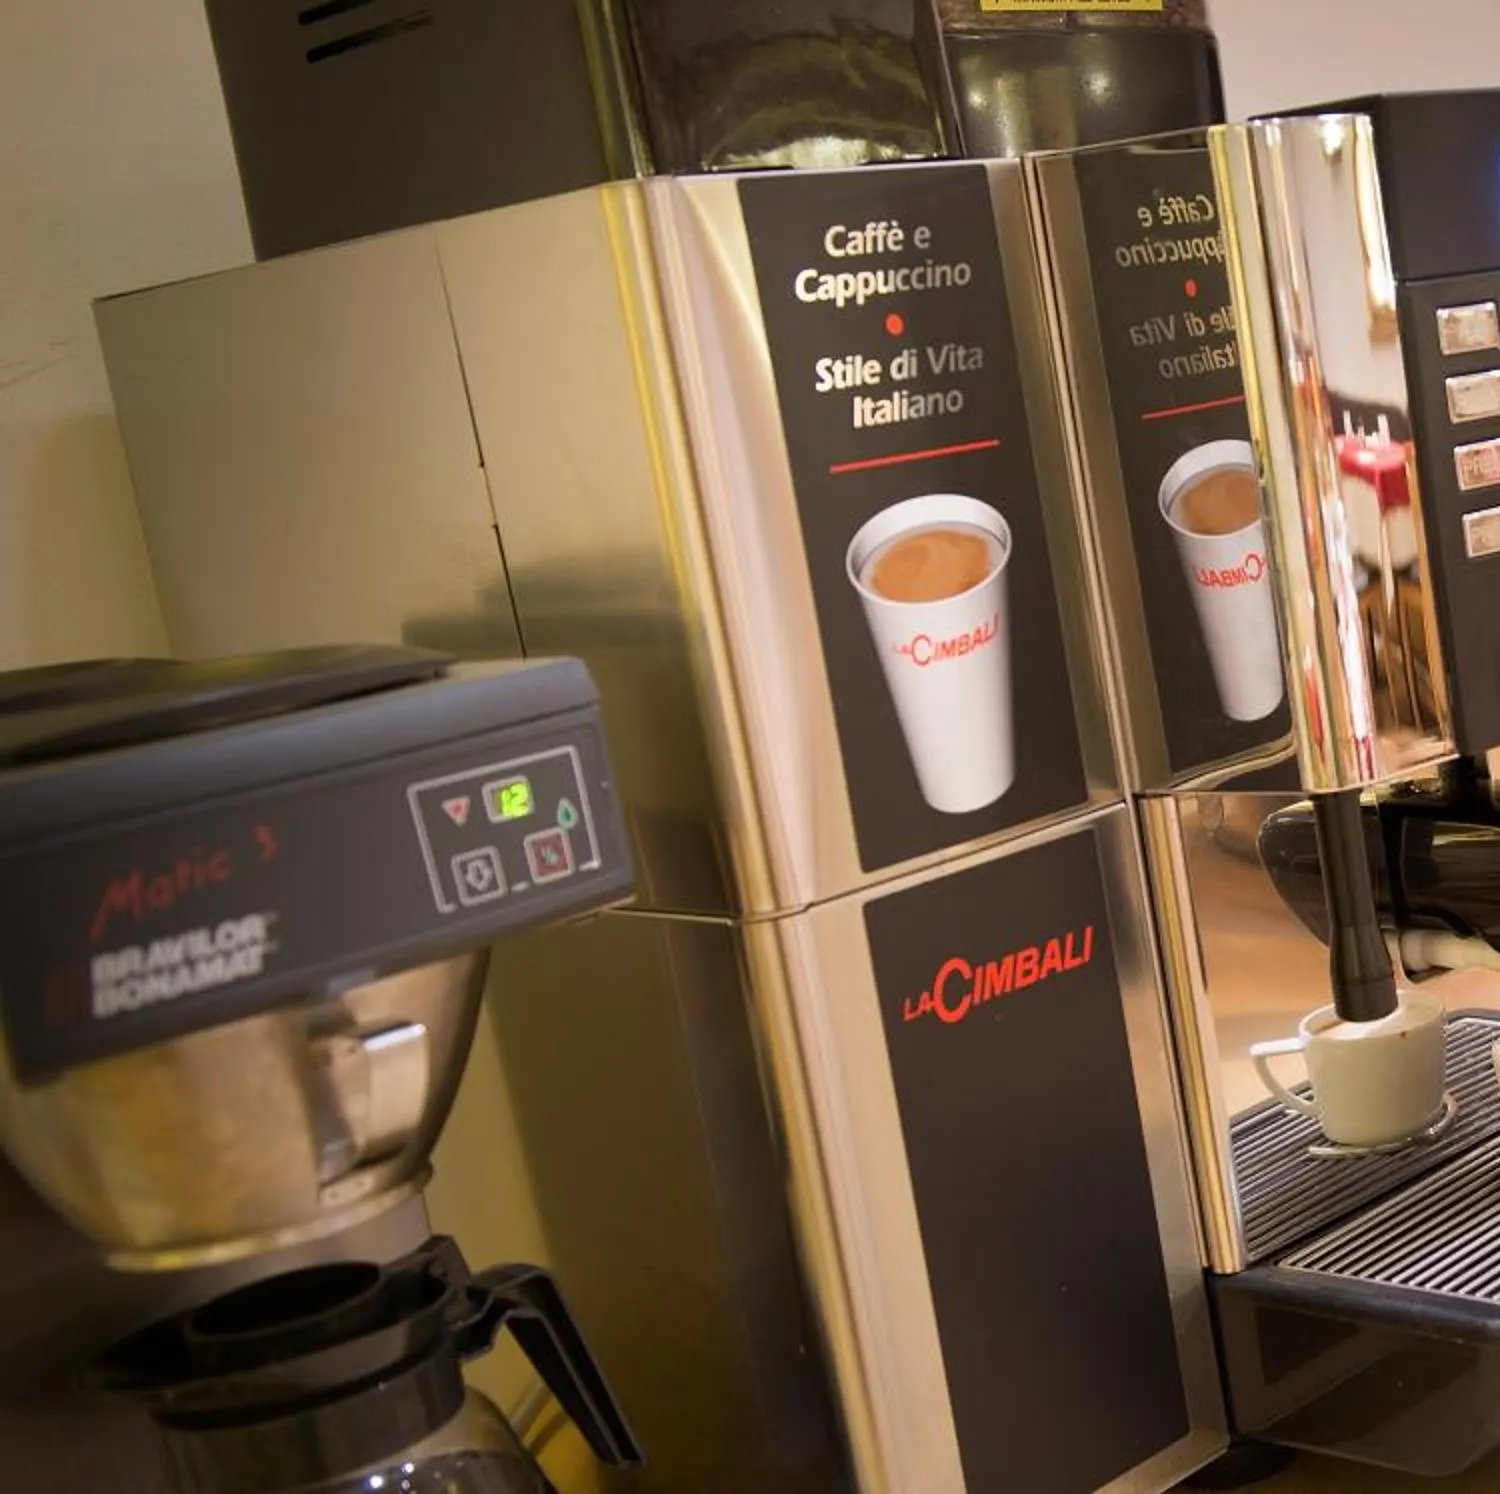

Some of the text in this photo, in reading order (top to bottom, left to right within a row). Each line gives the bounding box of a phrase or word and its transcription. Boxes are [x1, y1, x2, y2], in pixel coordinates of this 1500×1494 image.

[824, 221, 932, 257] Caffè e
[794, 259, 972, 307] Cappuccino
[815, 343, 984, 392] Stile di Vita
[853, 389, 964, 429] Italiano
